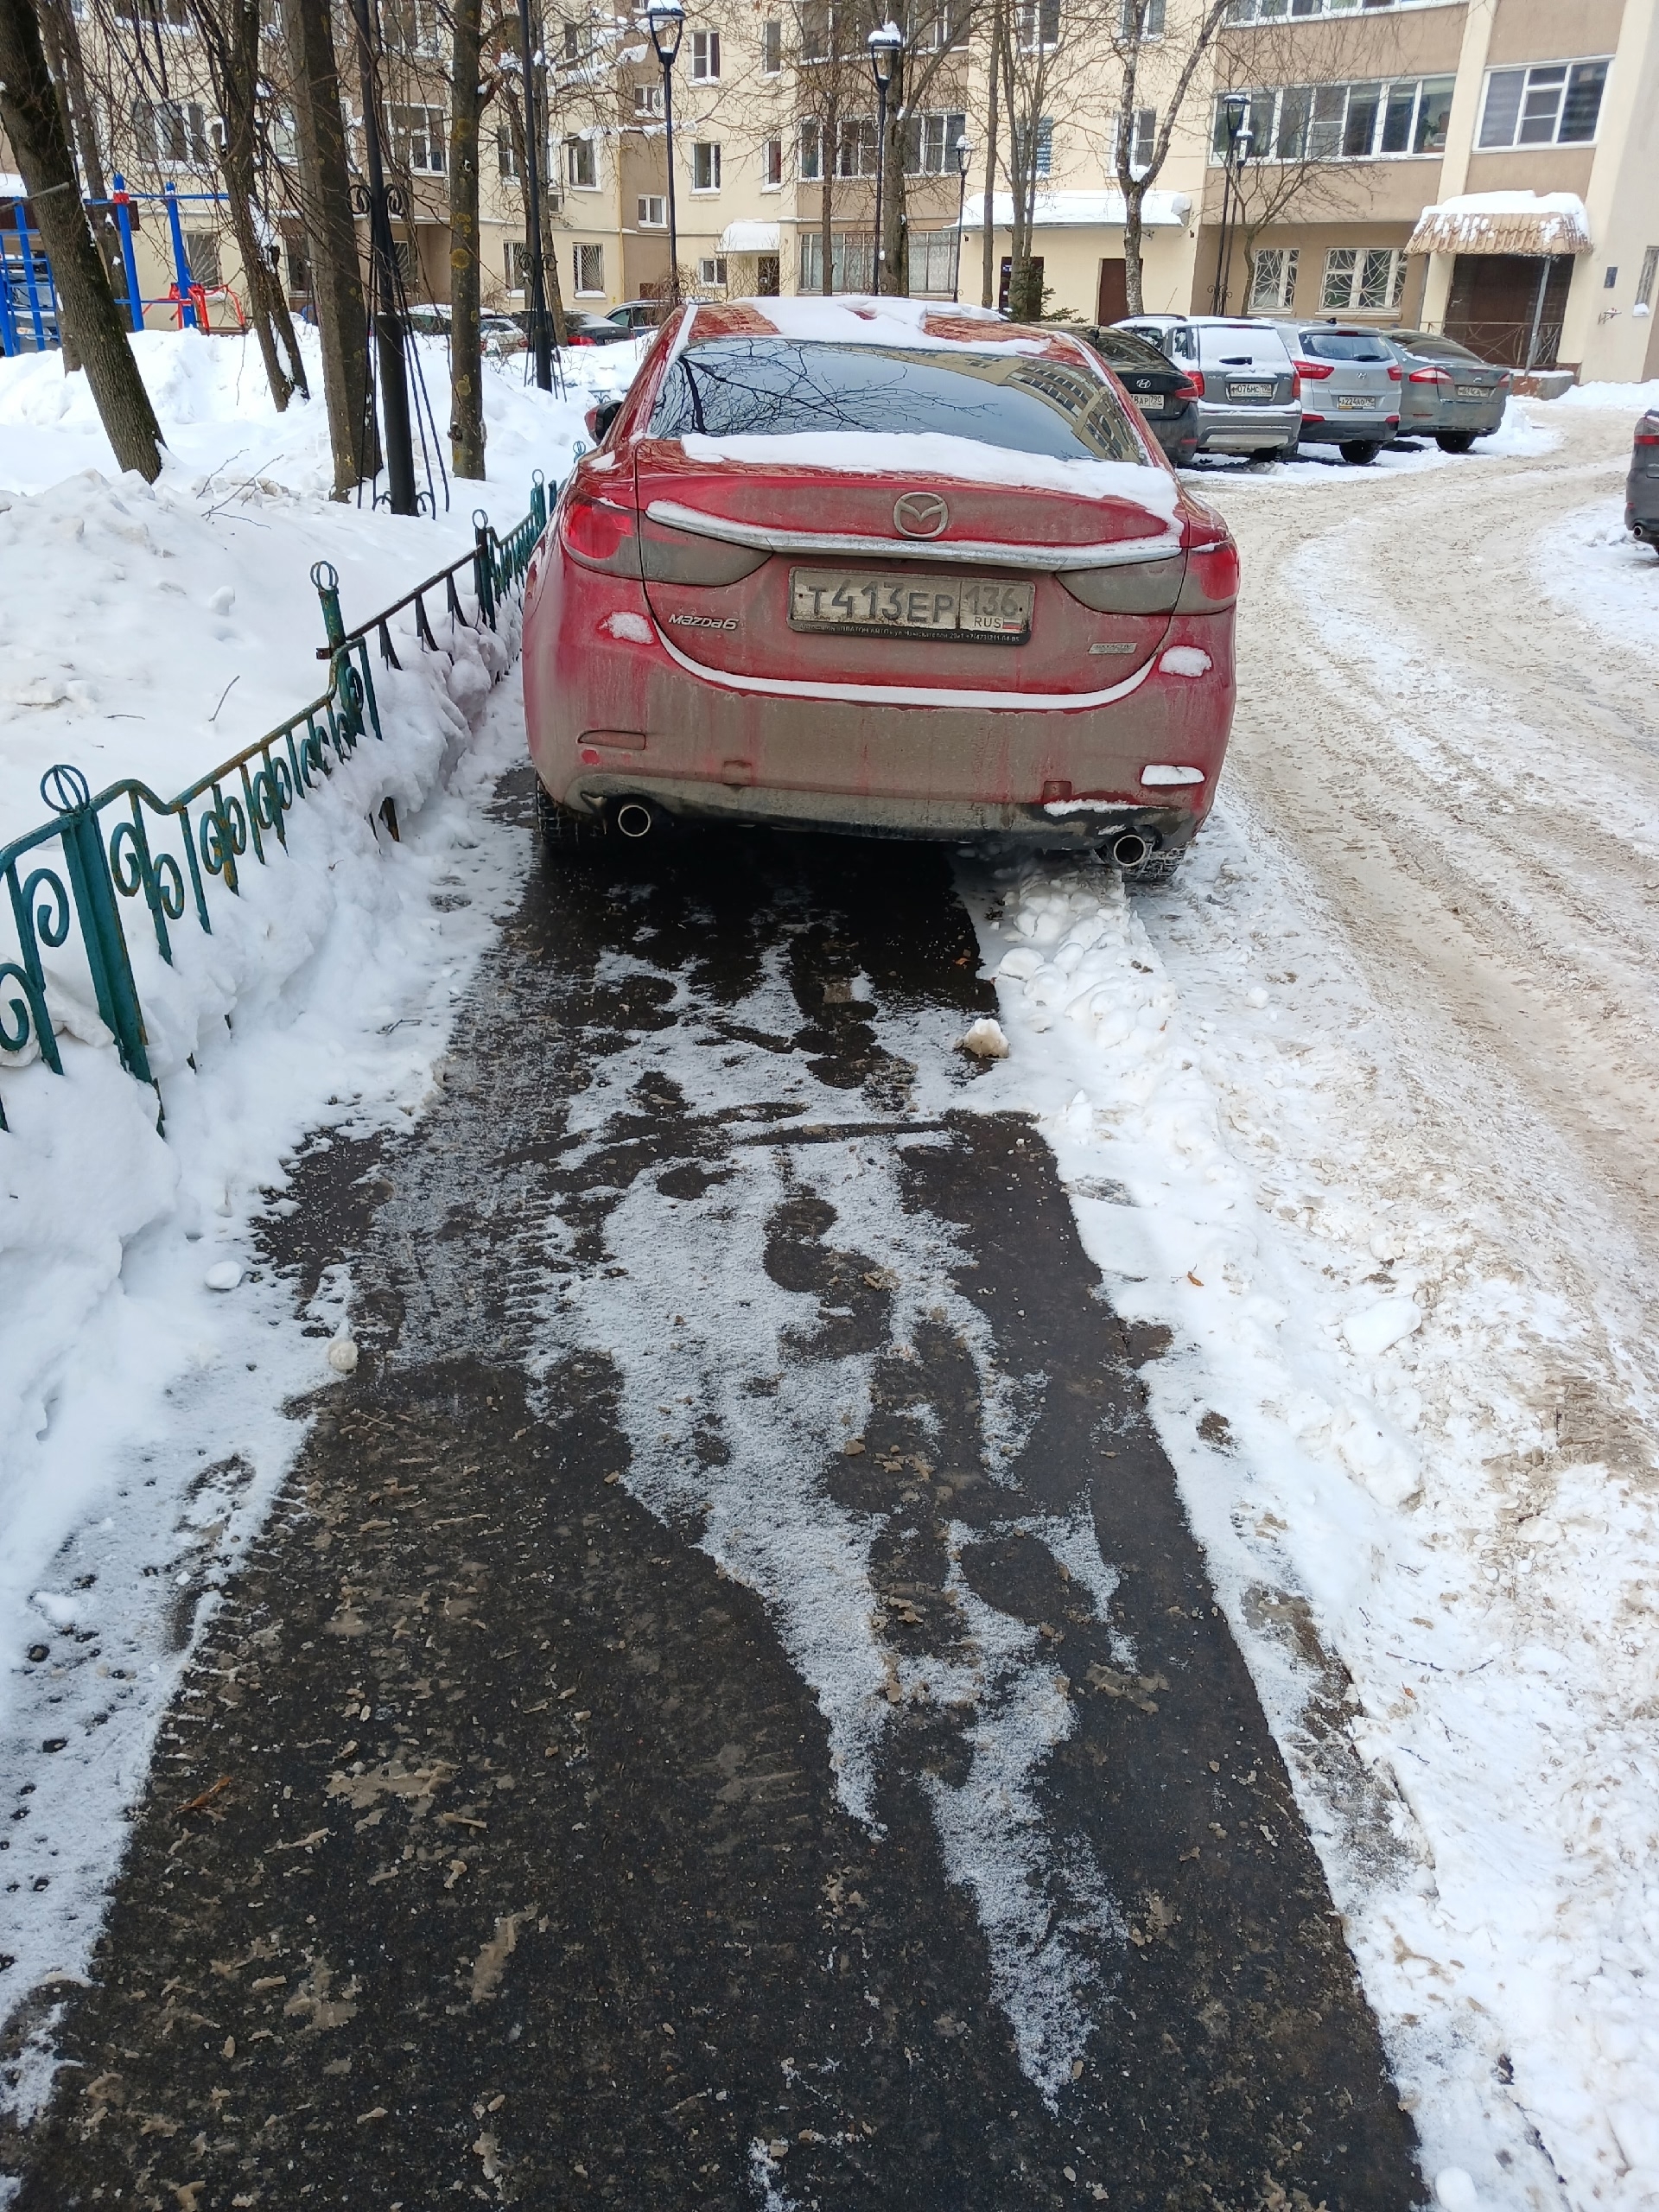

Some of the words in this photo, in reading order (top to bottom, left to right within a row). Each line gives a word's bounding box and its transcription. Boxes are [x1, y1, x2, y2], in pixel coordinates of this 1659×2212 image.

[808, 579, 953, 622] Т413ЕР
[964, 585, 1018, 616] 136
[974, 616, 1001, 628] RUS
